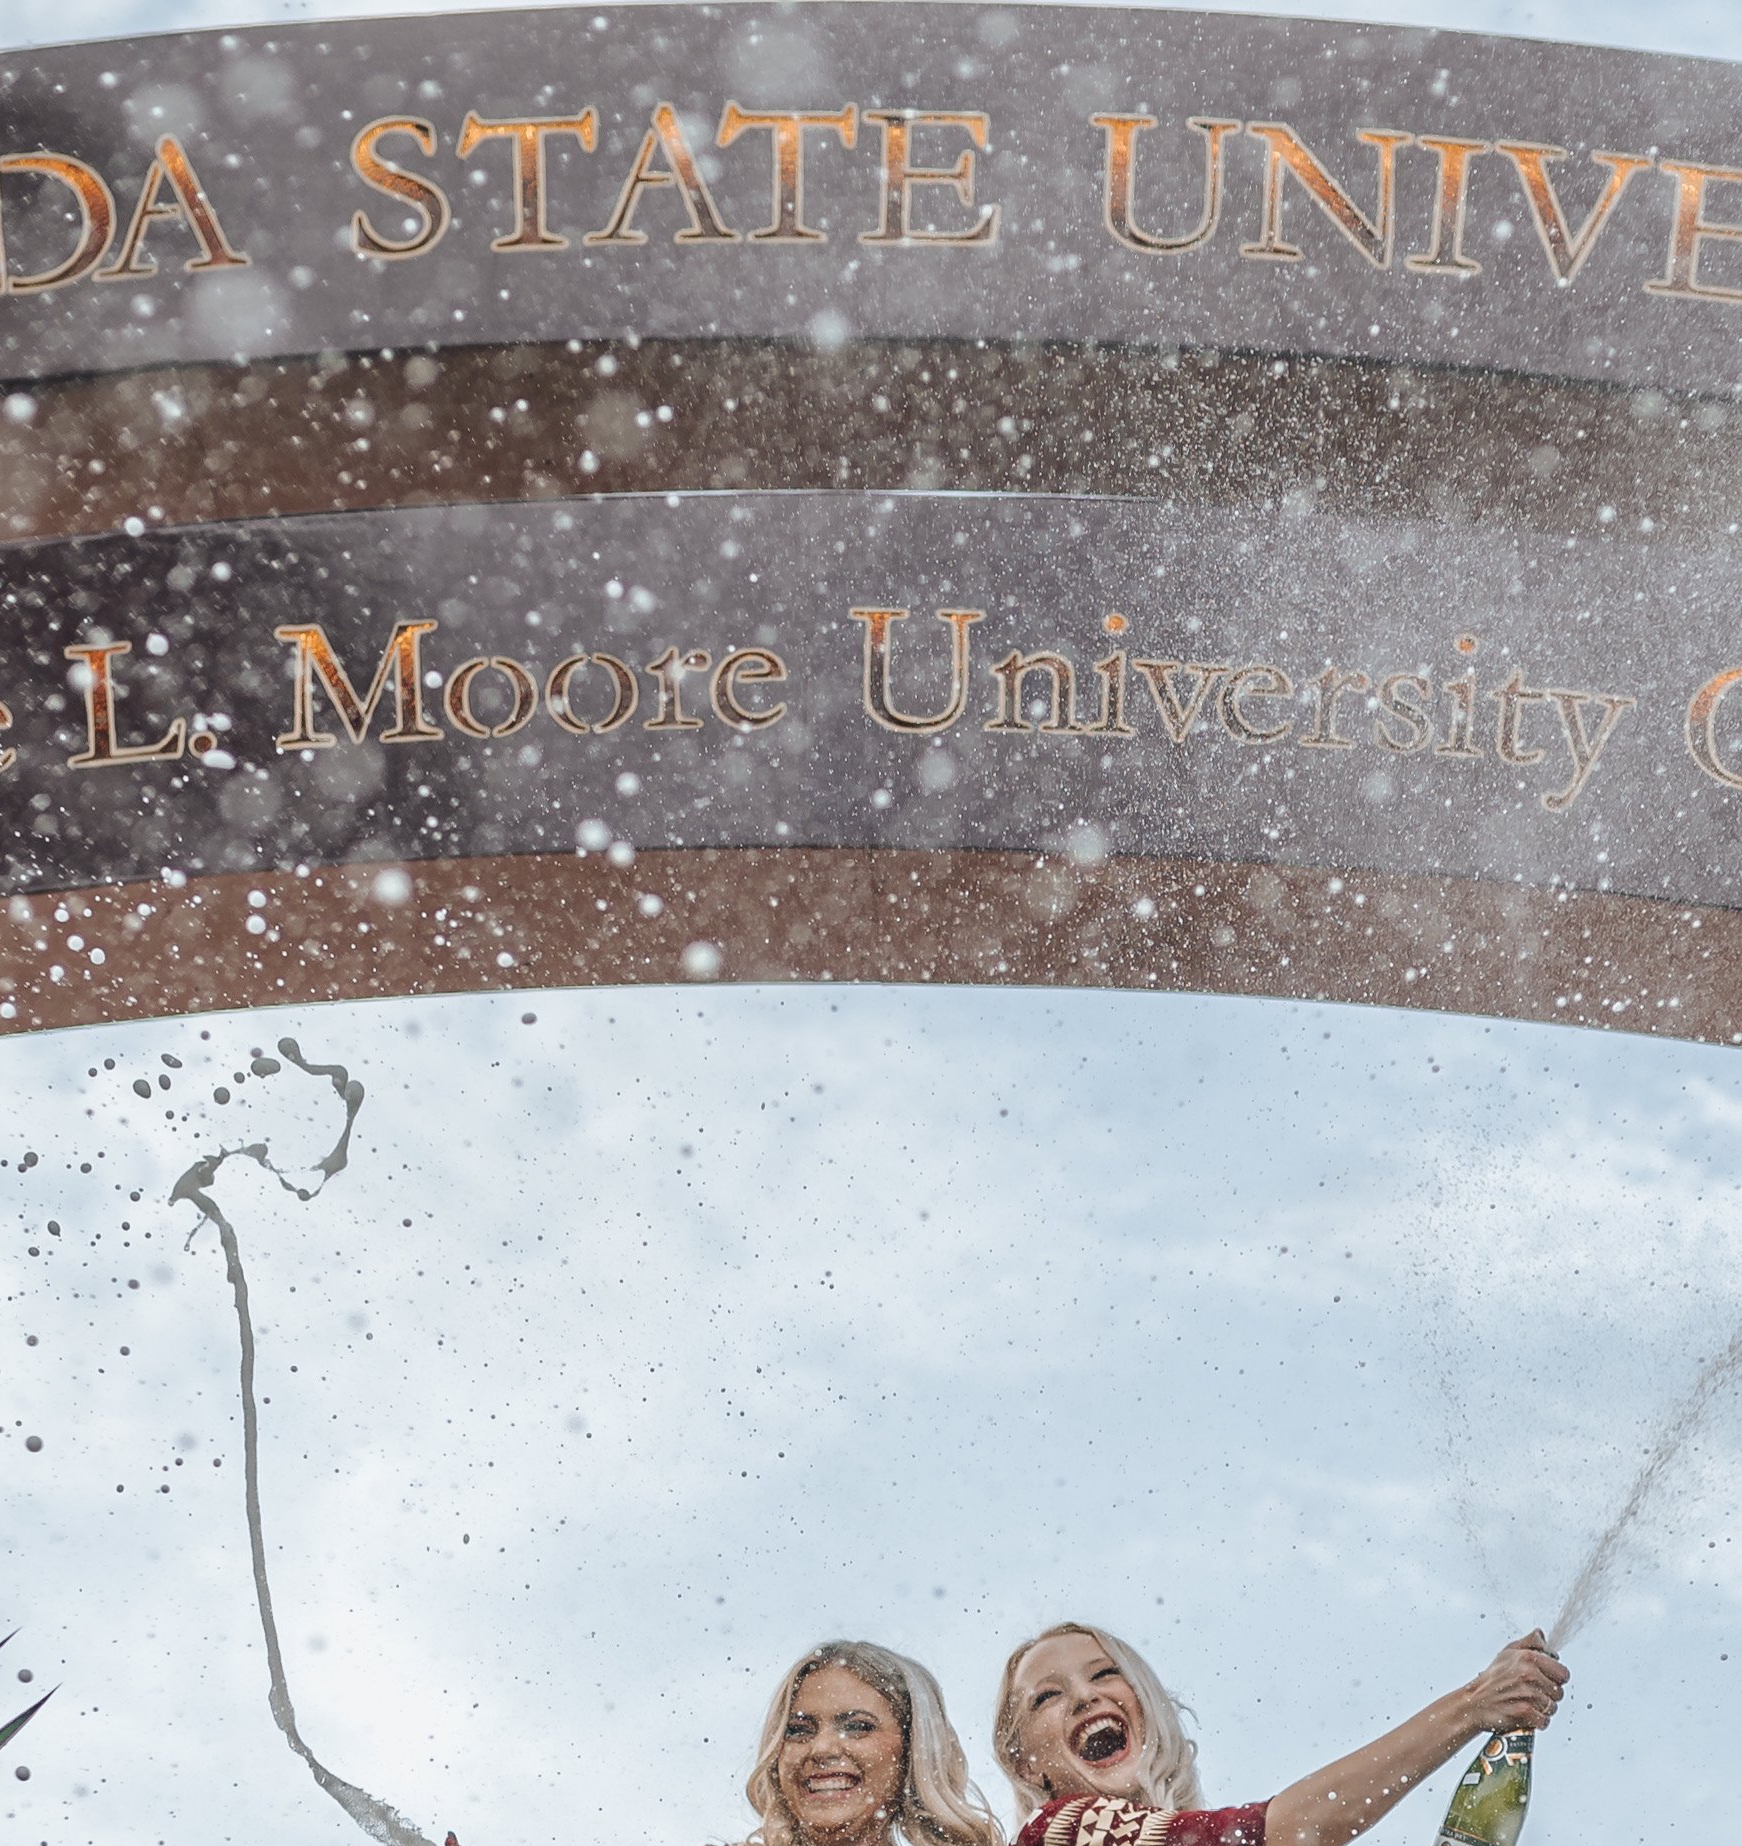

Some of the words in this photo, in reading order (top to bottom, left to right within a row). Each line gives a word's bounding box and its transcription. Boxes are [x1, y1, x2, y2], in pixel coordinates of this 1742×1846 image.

[350, 105, 1002, 258] STATE
[66, 642, 219, 770] L.
[273, 620, 790, 750] Moore
[849, 607, 1636, 811] University
